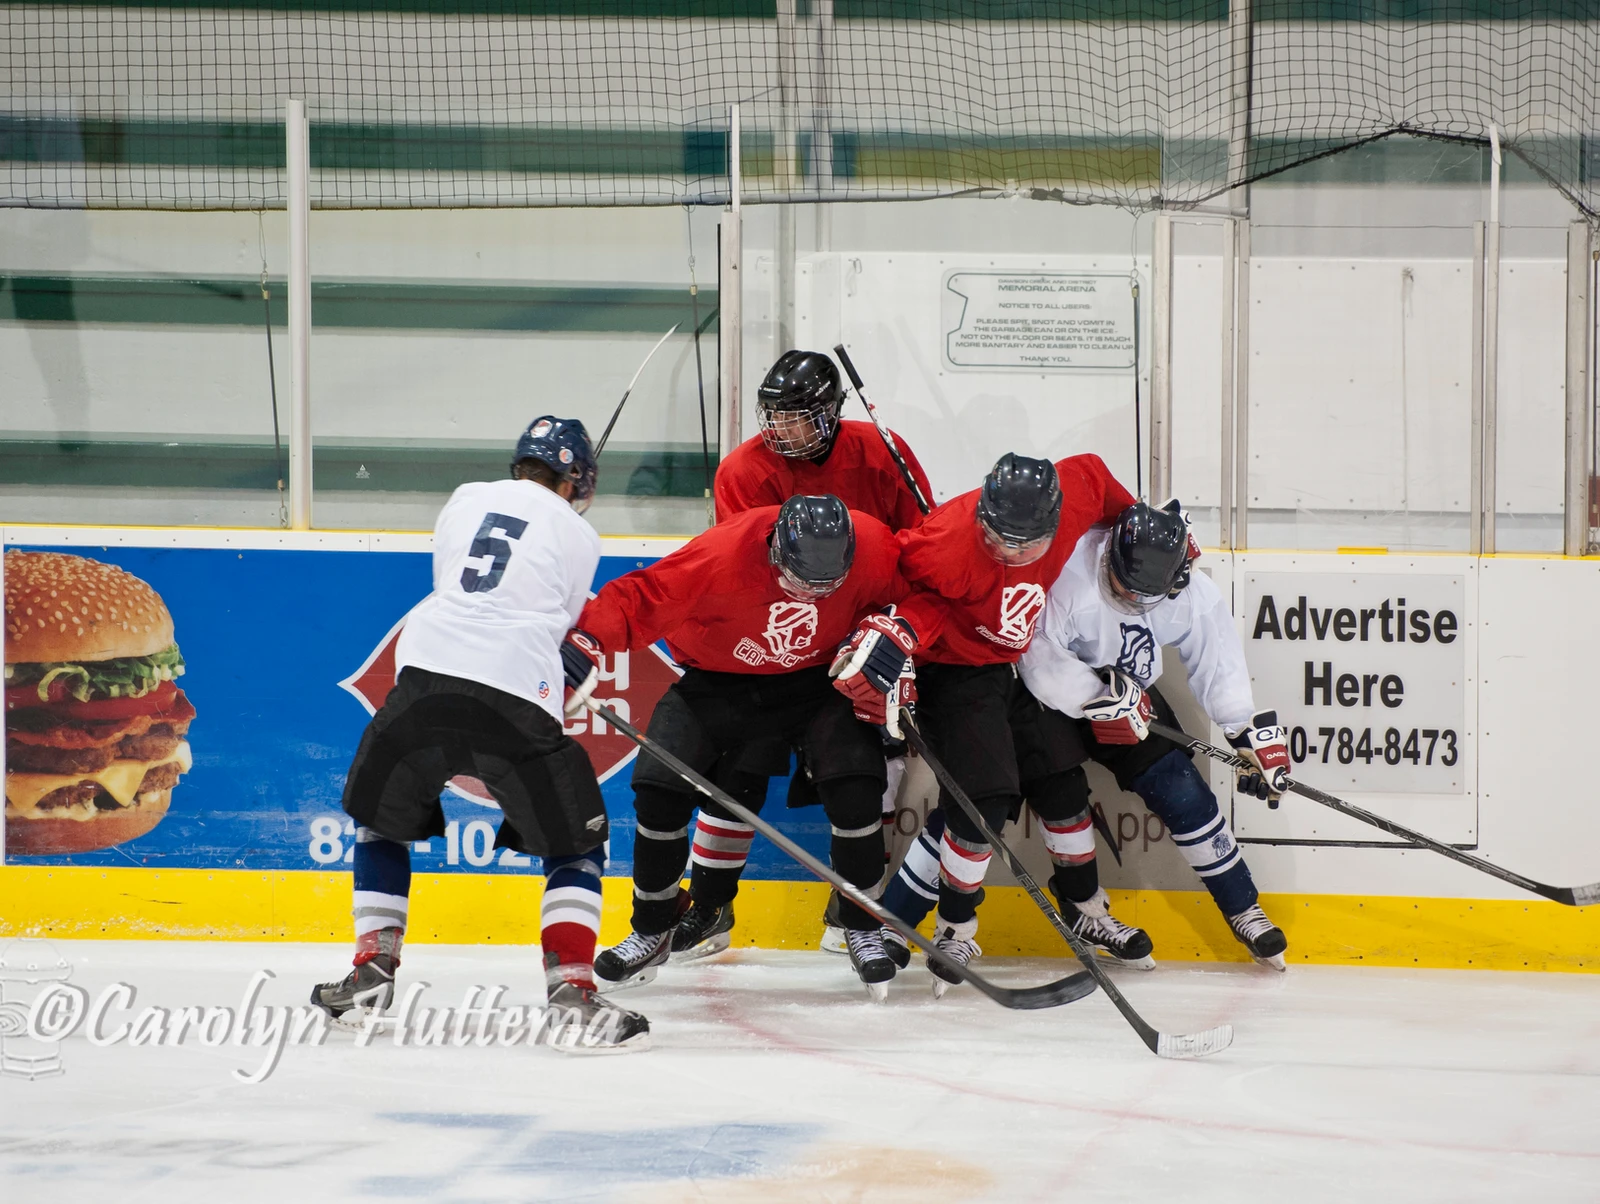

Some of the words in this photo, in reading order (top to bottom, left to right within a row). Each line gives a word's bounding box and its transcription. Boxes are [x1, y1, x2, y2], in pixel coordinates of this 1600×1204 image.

[459, 511, 530, 594] 5
[1252, 595, 1458, 644] Advertise
[1304, 661, 1404, 708] Here
